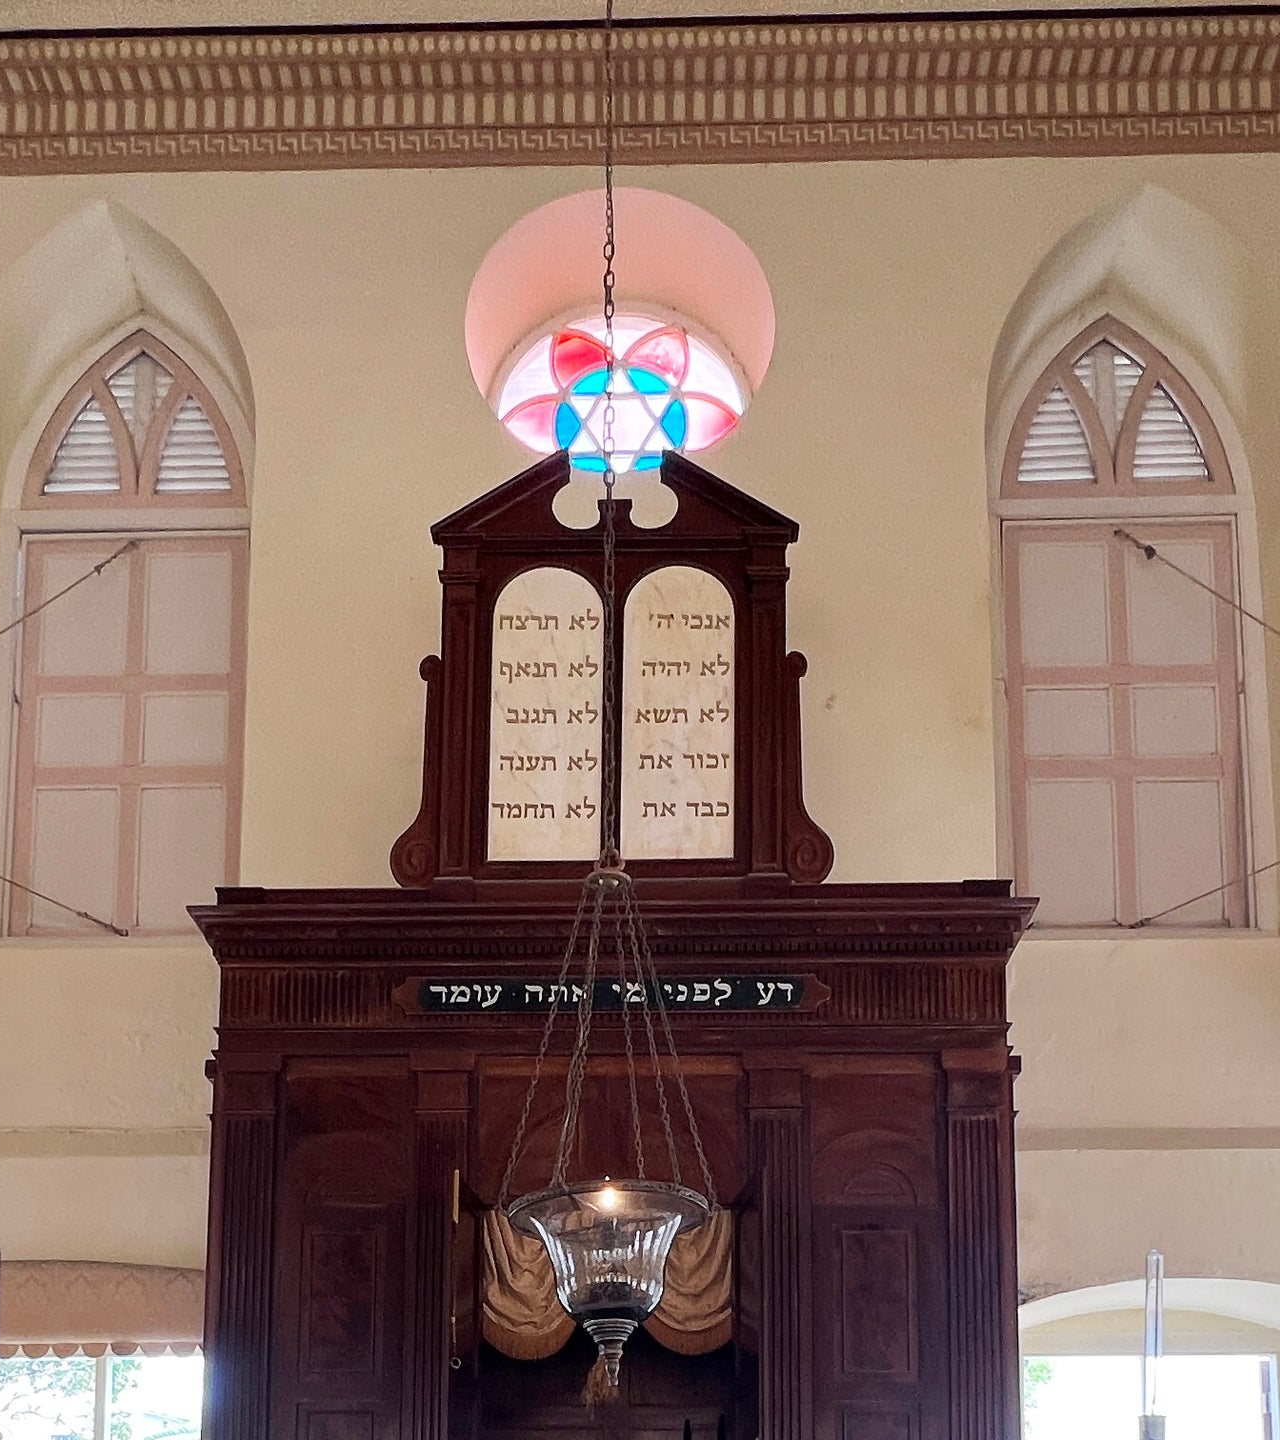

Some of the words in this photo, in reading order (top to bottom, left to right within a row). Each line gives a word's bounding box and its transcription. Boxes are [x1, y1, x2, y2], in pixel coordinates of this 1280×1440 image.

[498, 614, 559, 631] תרצח
[569, 608, 601, 631] לא
[680, 613, 731, 631] אנכי
[499, 661, 559, 684] תנאף
[567, 655, 598, 677] לא
[640, 661, 691, 677] יהיה
[698, 653, 730, 676] לא
[505, 708, 559, 724] תגנב
[567, 701, 598, 724] לא
[633, 707, 688, 724] תשא
[697, 700, 731, 723] לא
[500, 754, 559, 772] תענה
[566, 749, 599, 772] לא
[637, 753, 673, 770] את
[681, 752, 729, 769] זכור
[490, 802, 555, 819] תחמד
[563, 796, 596, 819] לא
[640, 801, 678, 818] את
[685, 801, 729, 817] כבד
[430, 985, 502, 1008] עומד
[612, 982, 646, 1002] מי
[664, 978, 733, 1006] לפני
[757, 982, 794, 1005] דע
